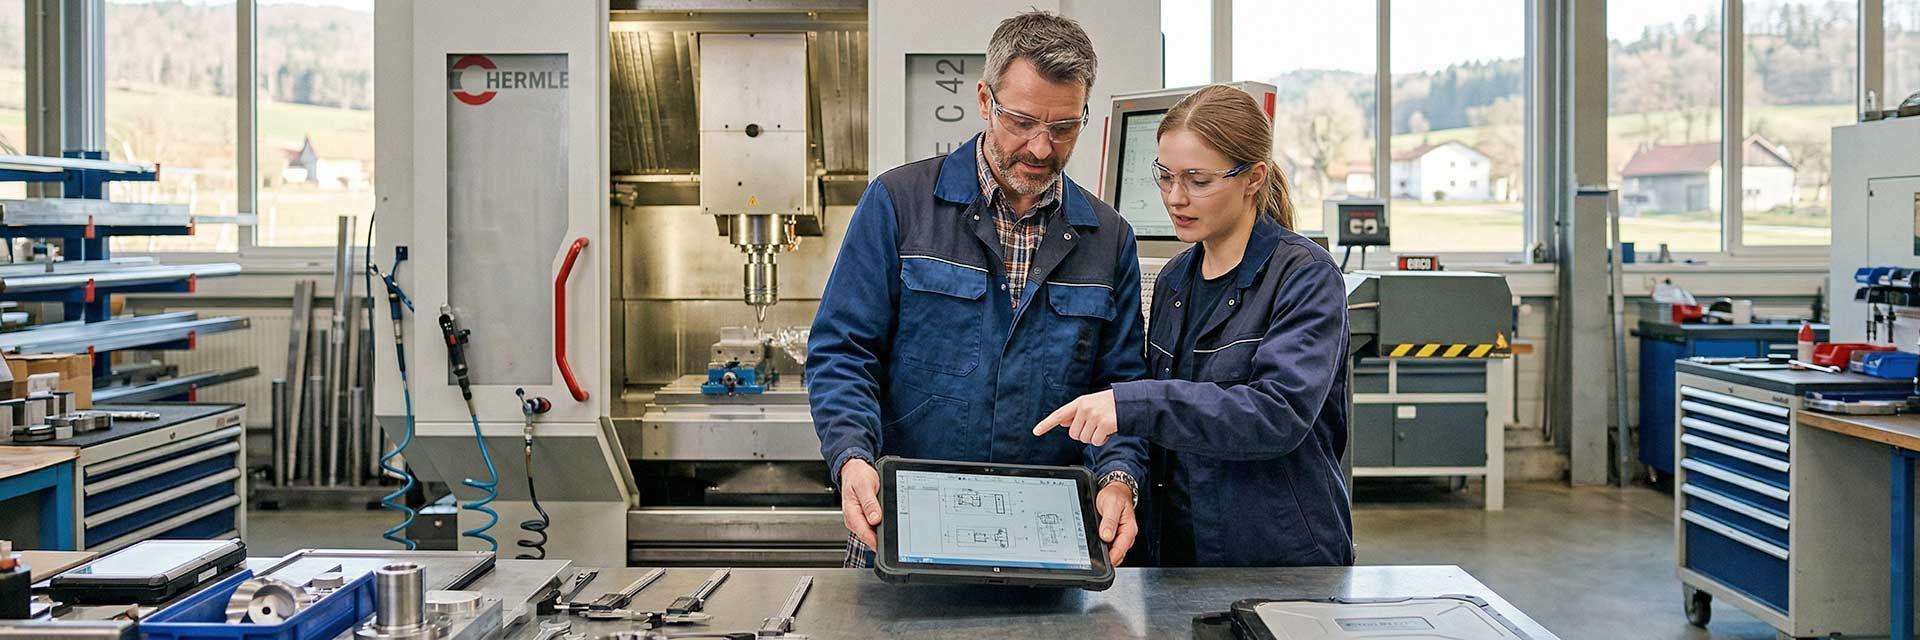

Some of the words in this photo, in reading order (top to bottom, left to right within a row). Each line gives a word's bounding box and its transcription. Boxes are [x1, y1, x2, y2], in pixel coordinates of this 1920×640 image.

[486, 71, 569, 89] HERMLE
[935, 59, 965, 94] 42
[935, 105, 965, 122] C
